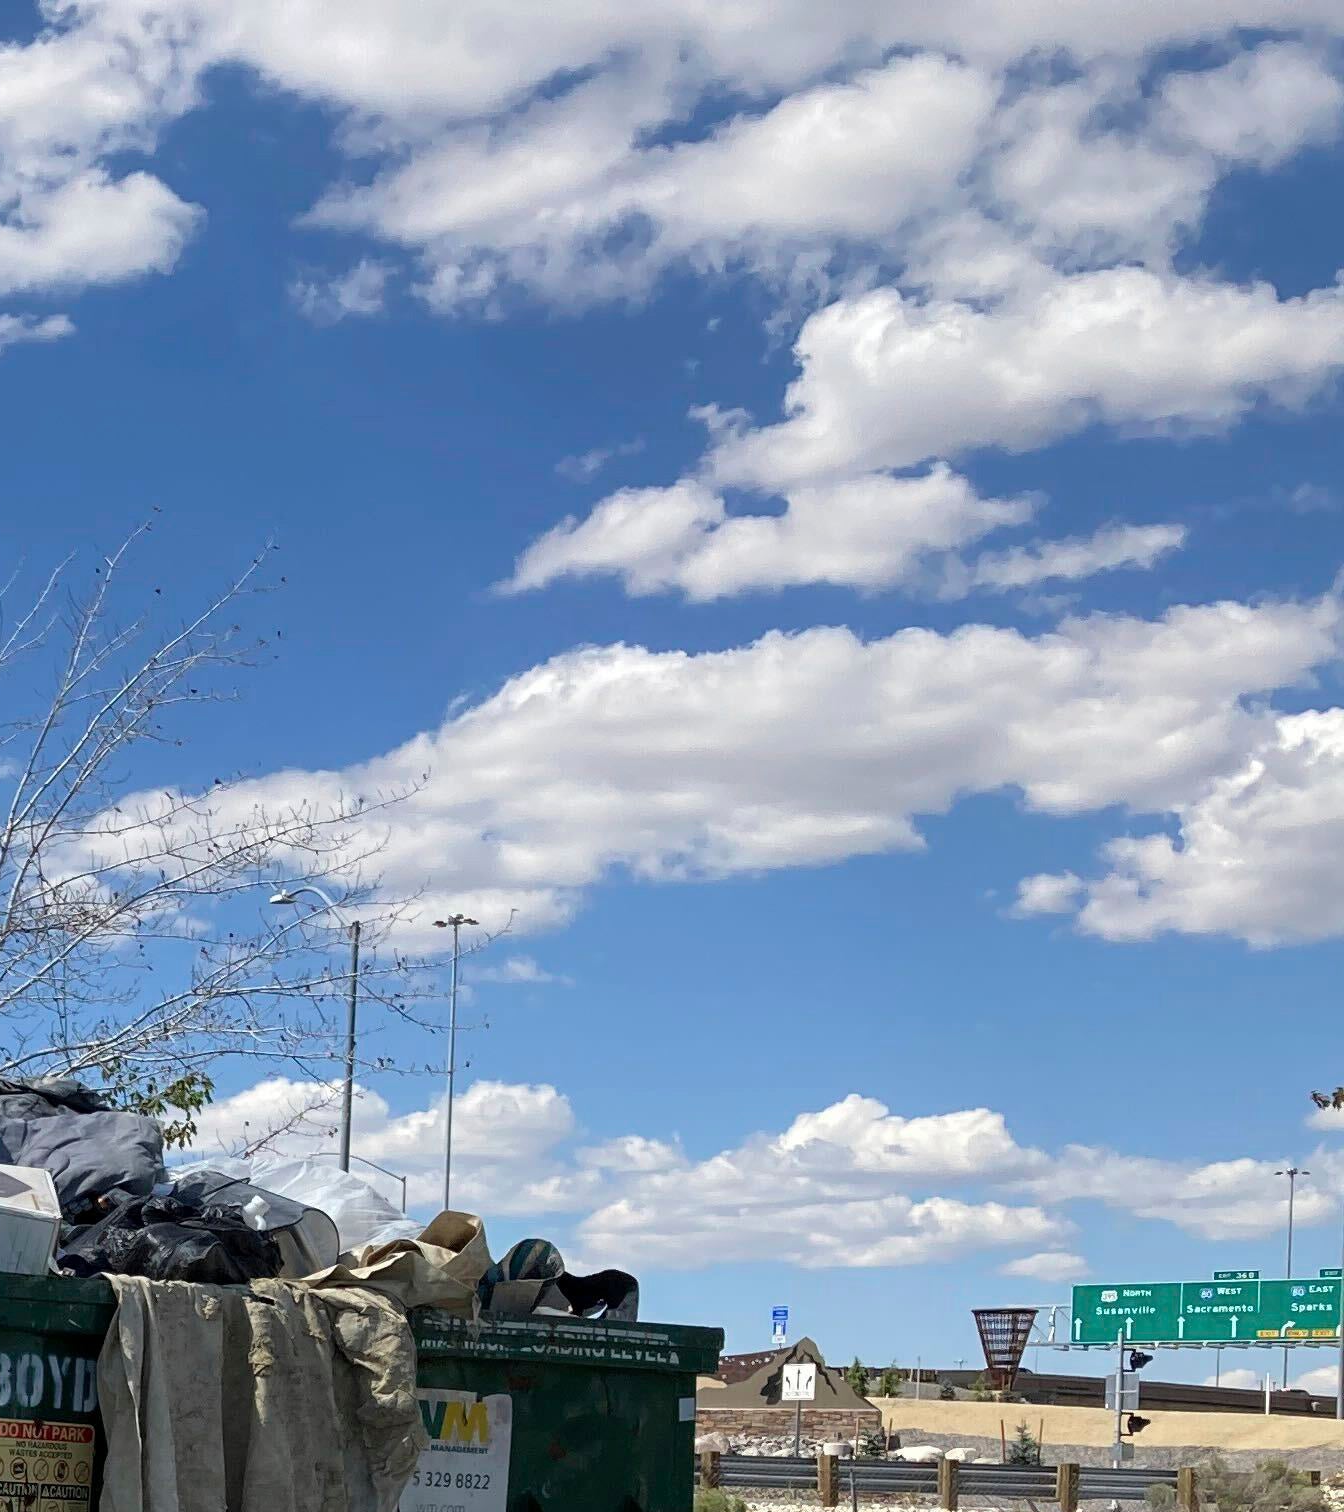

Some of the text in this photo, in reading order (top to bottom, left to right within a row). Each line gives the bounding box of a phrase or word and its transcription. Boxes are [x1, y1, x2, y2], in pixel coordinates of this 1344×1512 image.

[1123, 1289, 1152, 1297] NORTH
[1217, 1287, 1242, 1295] WEST
[1309, 1285, 1334, 1293] EAST
[1096, 1306, 1156, 1315] Susanville
[1187, 1304, 1254, 1314] Sacramento
[1291, 1302, 1333, 1313] Sparks
[0, 1423, 86, 1442] DO NOT PARK
[15, 1440, 26, 1448] NO
[430, 1444, 489, 1455] MANAGEMENT
[425, 1472, 452, 1488] 329
[455, 1473, 490, 1490] 8822
[50, 1486, 89, 1499] CAUTION
